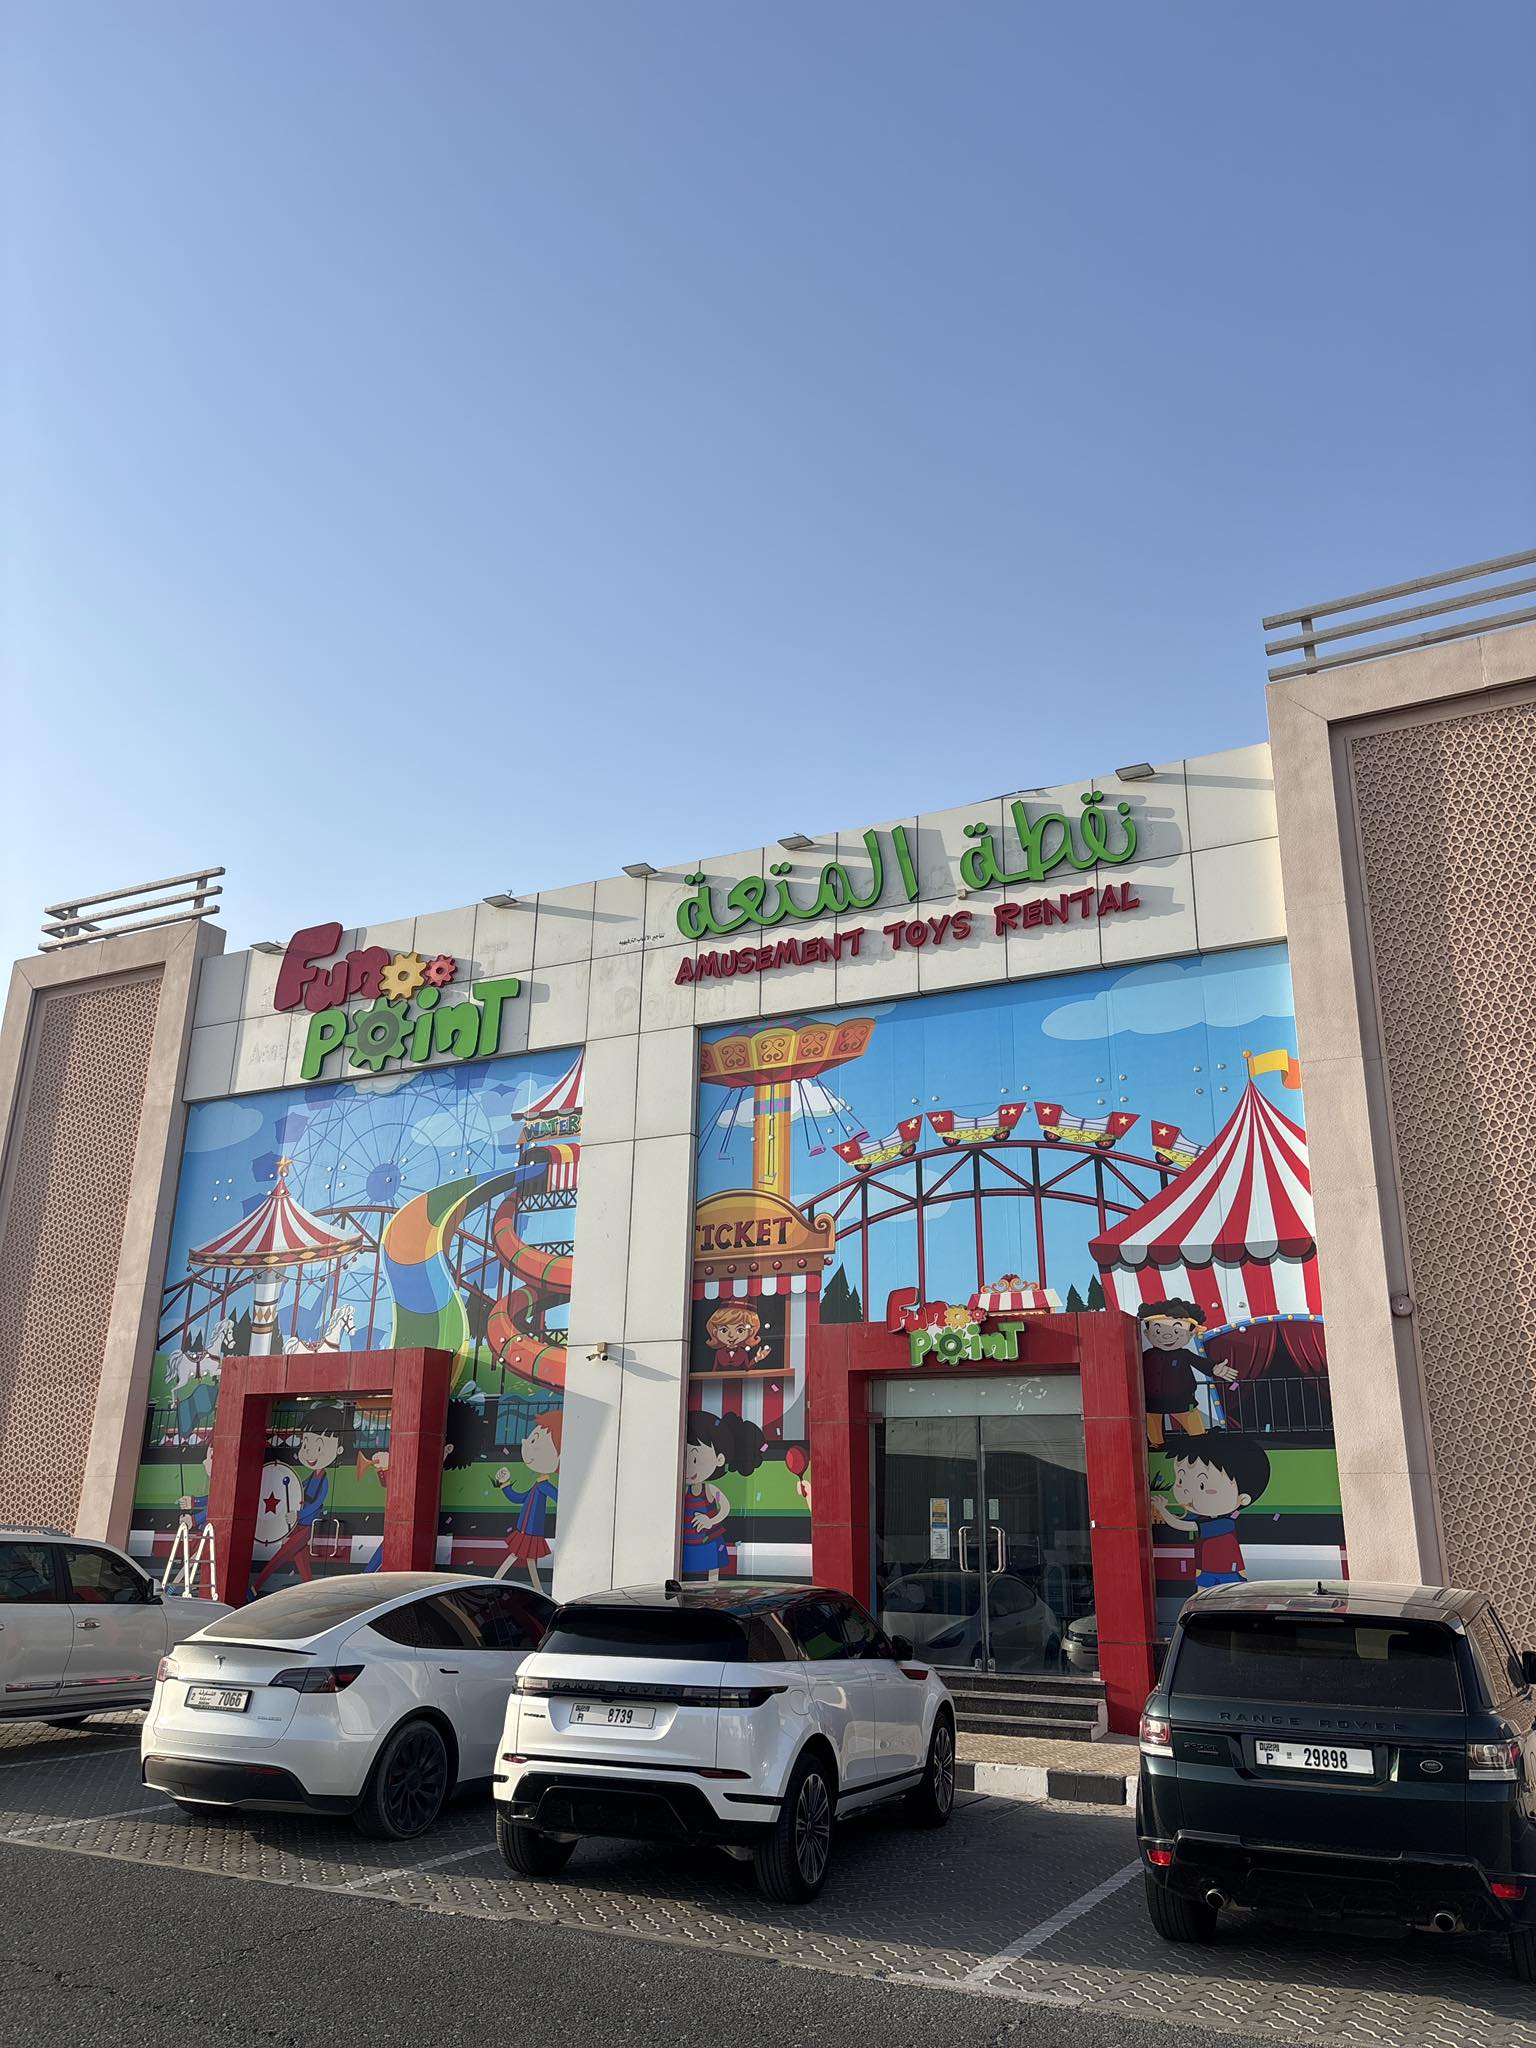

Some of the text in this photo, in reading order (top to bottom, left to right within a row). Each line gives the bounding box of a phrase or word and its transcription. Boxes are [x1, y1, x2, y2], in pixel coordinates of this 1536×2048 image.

[676, 790, 1139, 940] نقطة المتعة
[674, 881, 1140, 986] AMUSEMENT TOYS RENTAL
[523, 1114, 581, 1141] WATER
[695, 1216, 793, 1251] ICKET
[190, 1692, 196, 1701] 2
[218, 1691, 243, 1707] 7066
[576, 1708, 633, 1724] R 8739
[1218, 1712, 1407, 1732] RANGE ROVER
[1265, 1747, 1348, 1770] P 29898
